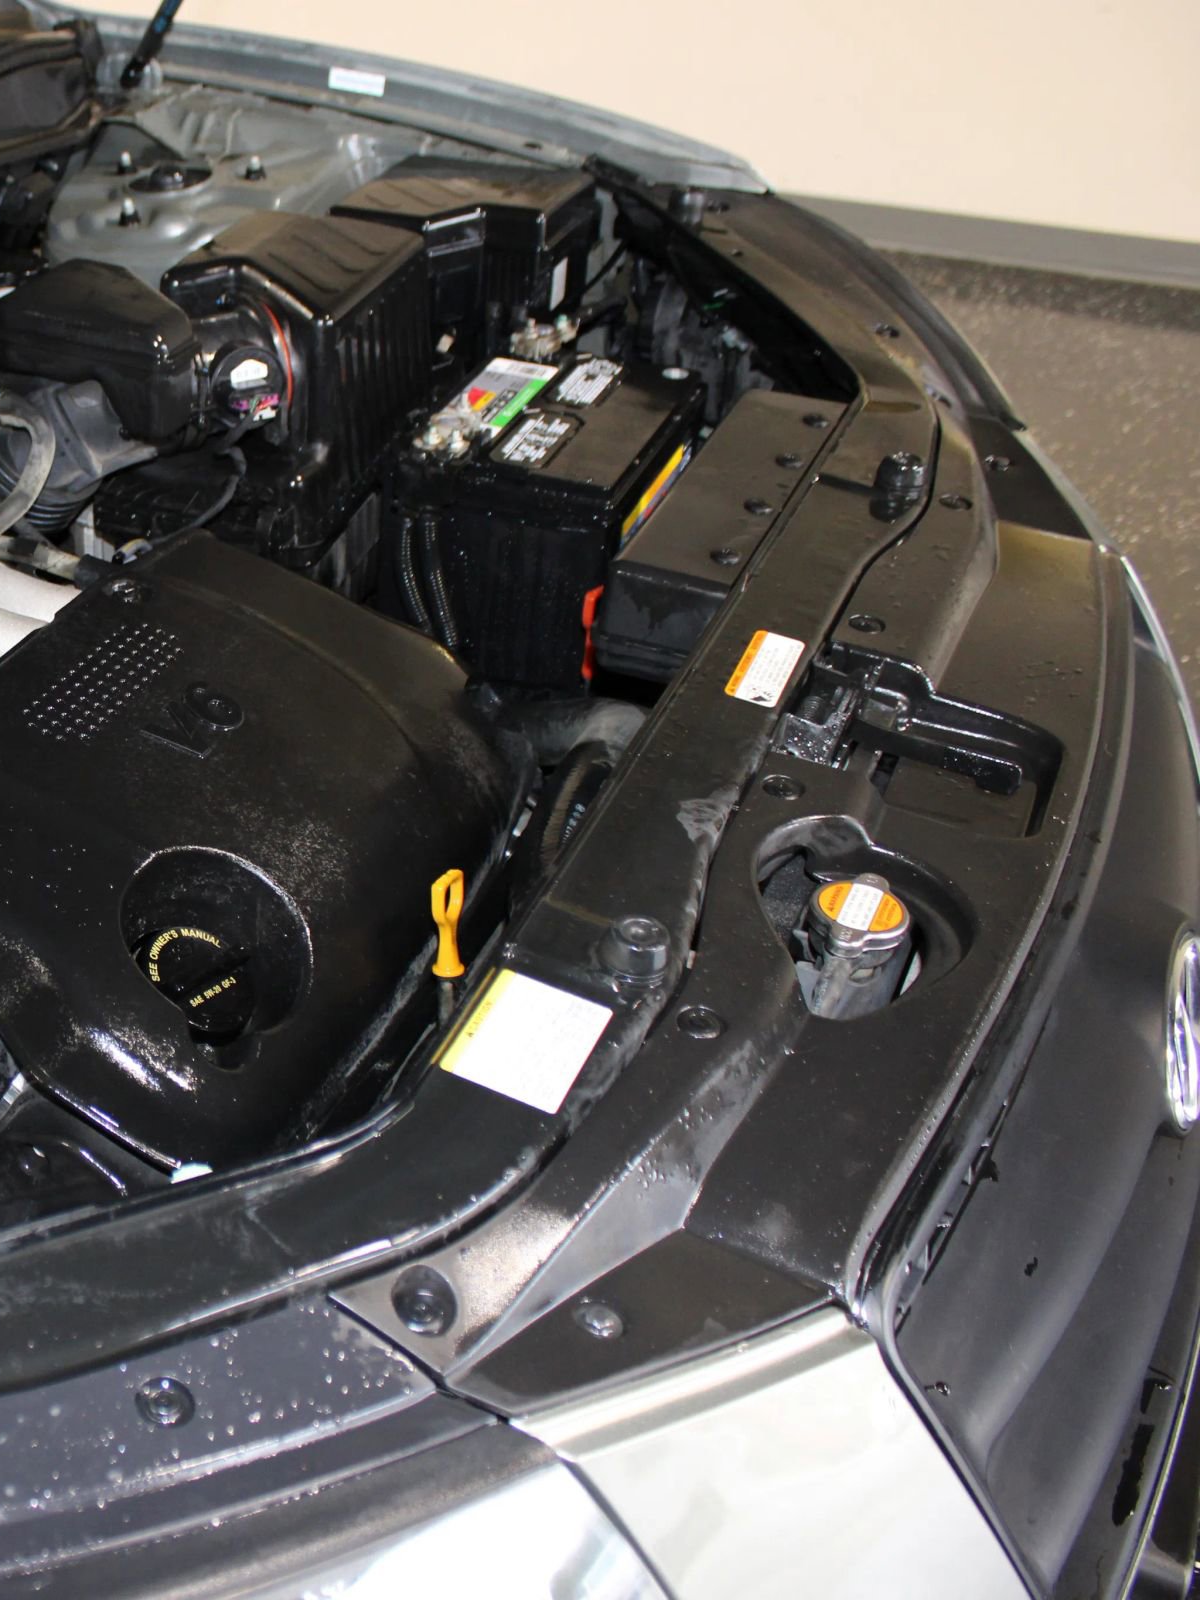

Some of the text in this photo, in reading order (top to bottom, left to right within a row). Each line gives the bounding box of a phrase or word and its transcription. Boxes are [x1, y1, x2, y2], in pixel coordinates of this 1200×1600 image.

[149, 928, 221, 982] SEE OWNER'S MANUAL
[189, 995, 204, 1007] SAE
